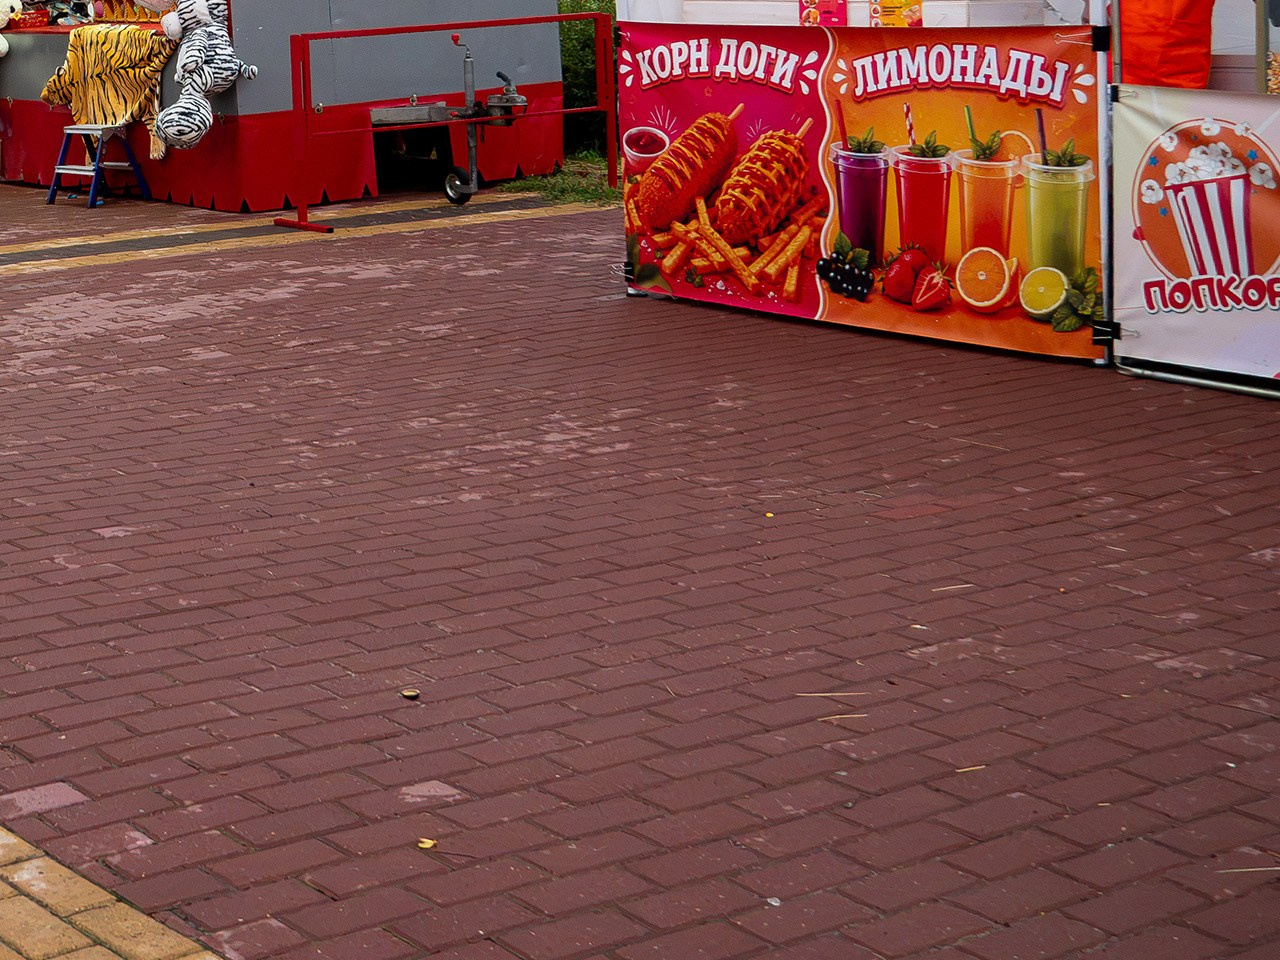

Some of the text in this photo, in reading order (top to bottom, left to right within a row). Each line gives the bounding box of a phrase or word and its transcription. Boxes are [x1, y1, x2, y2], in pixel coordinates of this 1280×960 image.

[636, 38, 799, 89] КОРН ДОГИ
[853, 44, 1069, 102] ЛИМОНАДЫ
